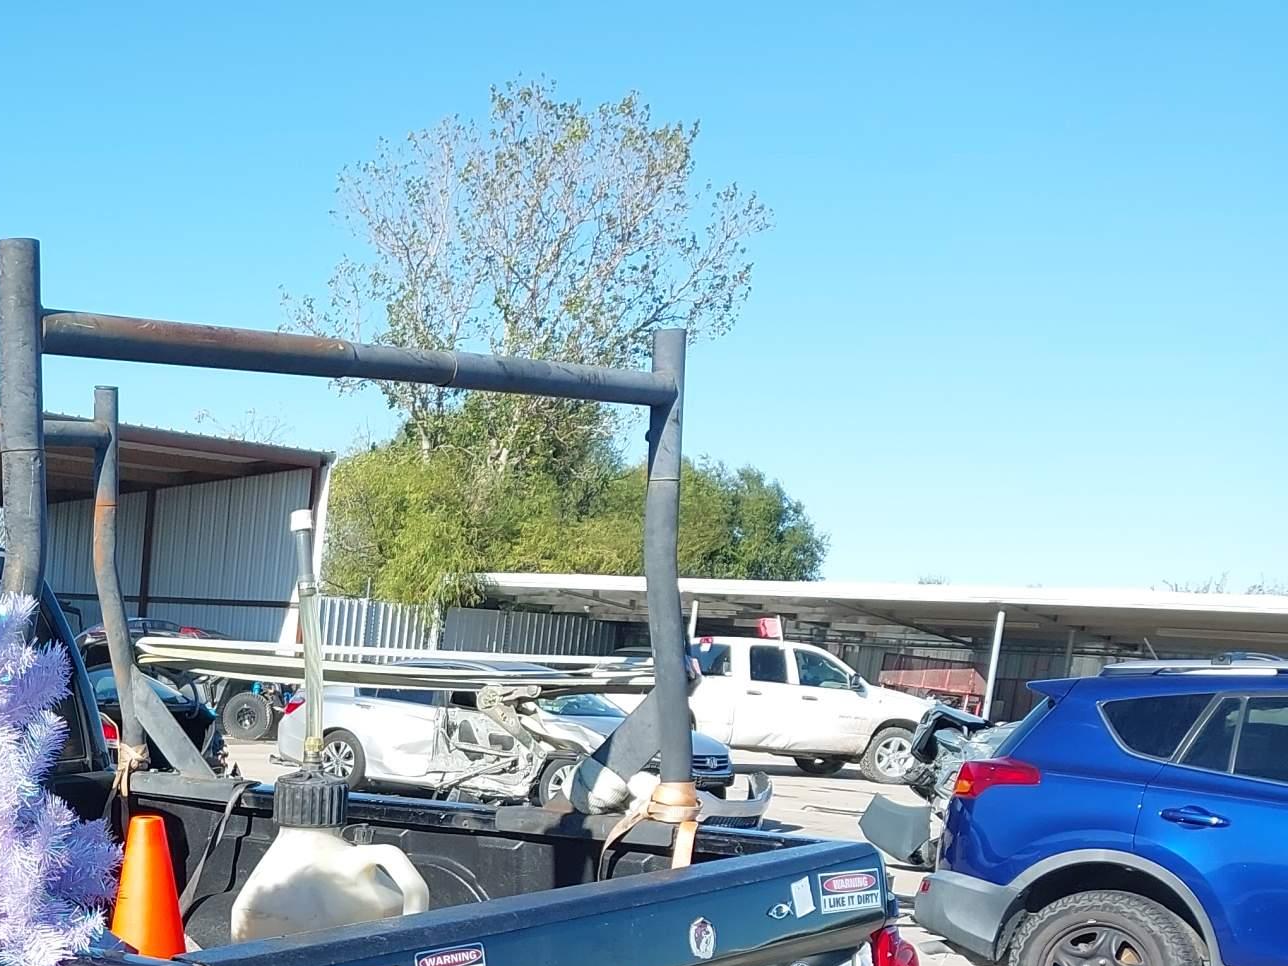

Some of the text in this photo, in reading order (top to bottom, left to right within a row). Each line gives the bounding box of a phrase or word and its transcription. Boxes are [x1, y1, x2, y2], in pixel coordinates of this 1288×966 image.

[833, 877, 868, 890] WARNING
[823, 892, 879, 909] I LIKE IT DIRTY
[424, 950, 477, 966] WARNING
